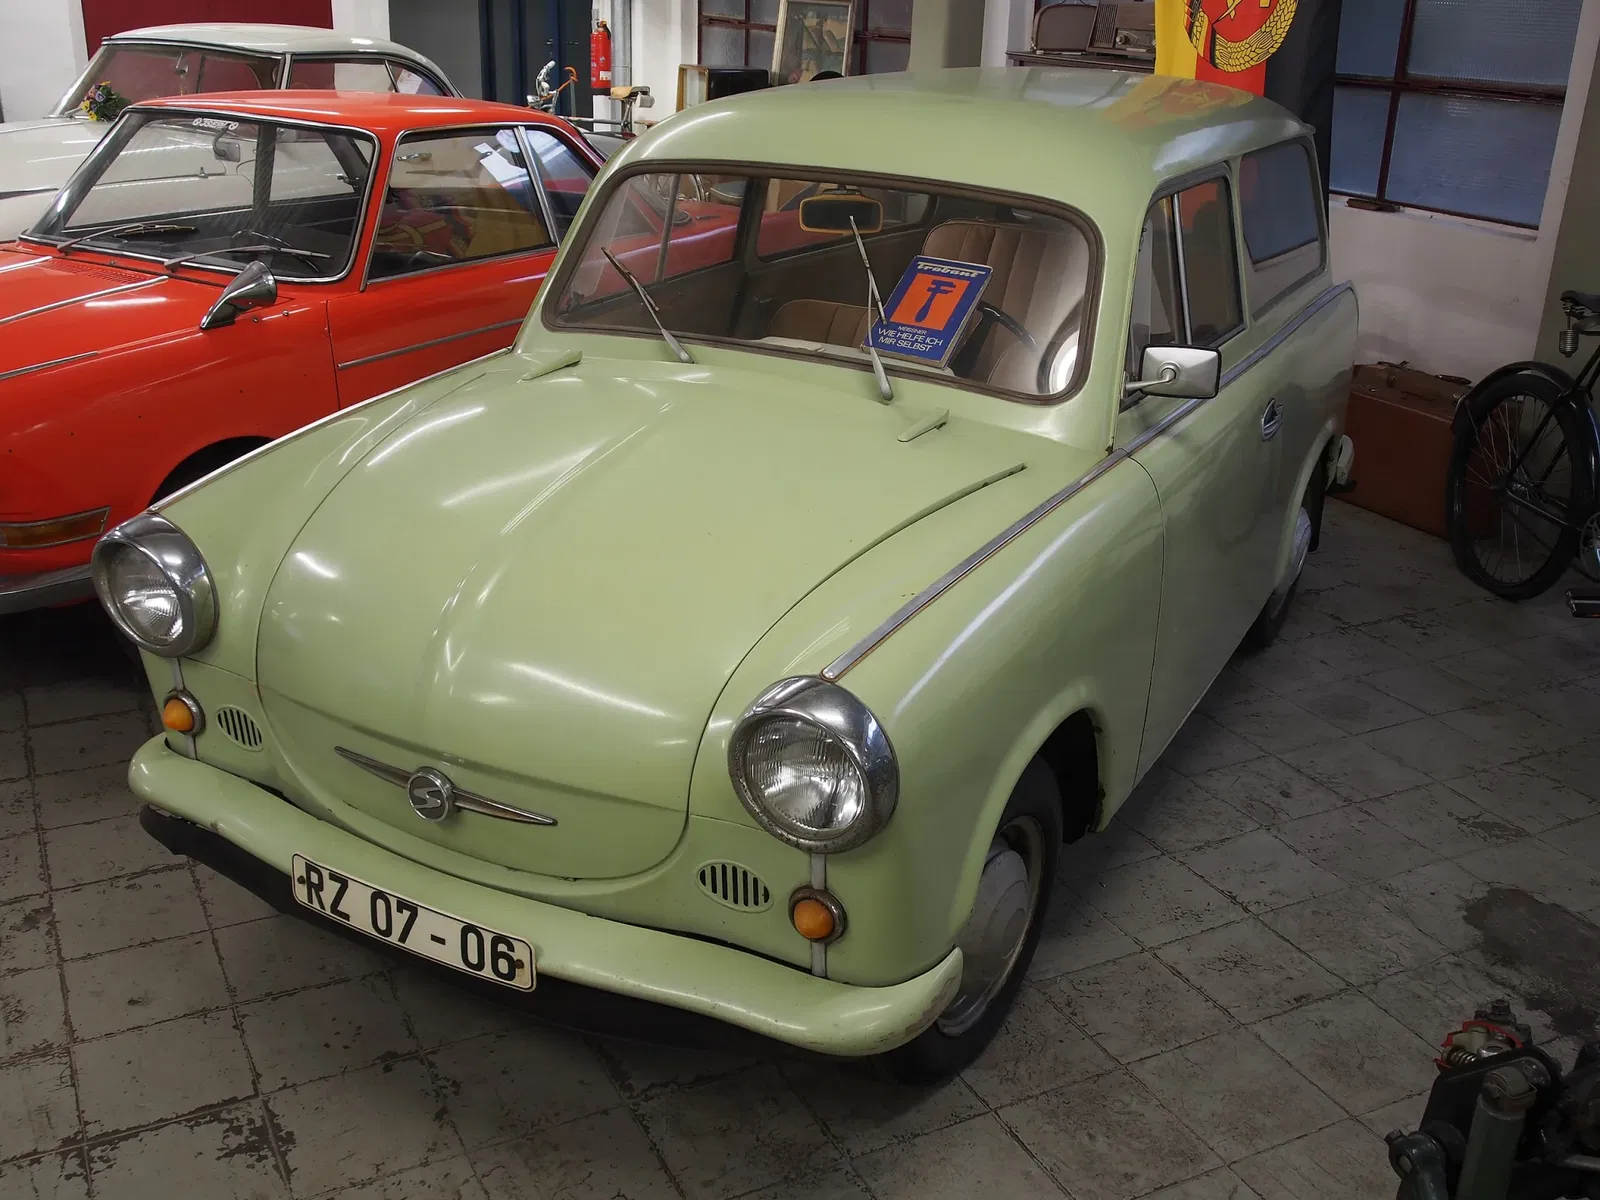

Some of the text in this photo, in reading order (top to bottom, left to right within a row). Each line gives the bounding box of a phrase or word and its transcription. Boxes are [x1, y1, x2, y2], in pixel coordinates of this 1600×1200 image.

[878, 328, 943, 346] WIE HELFE ICH
[878, 336, 932, 352] MIR SELBST
[304, 861, 351, 922] RZ
[370, 890, 419, 945] 07
[460, 923, 517, 982] 06
